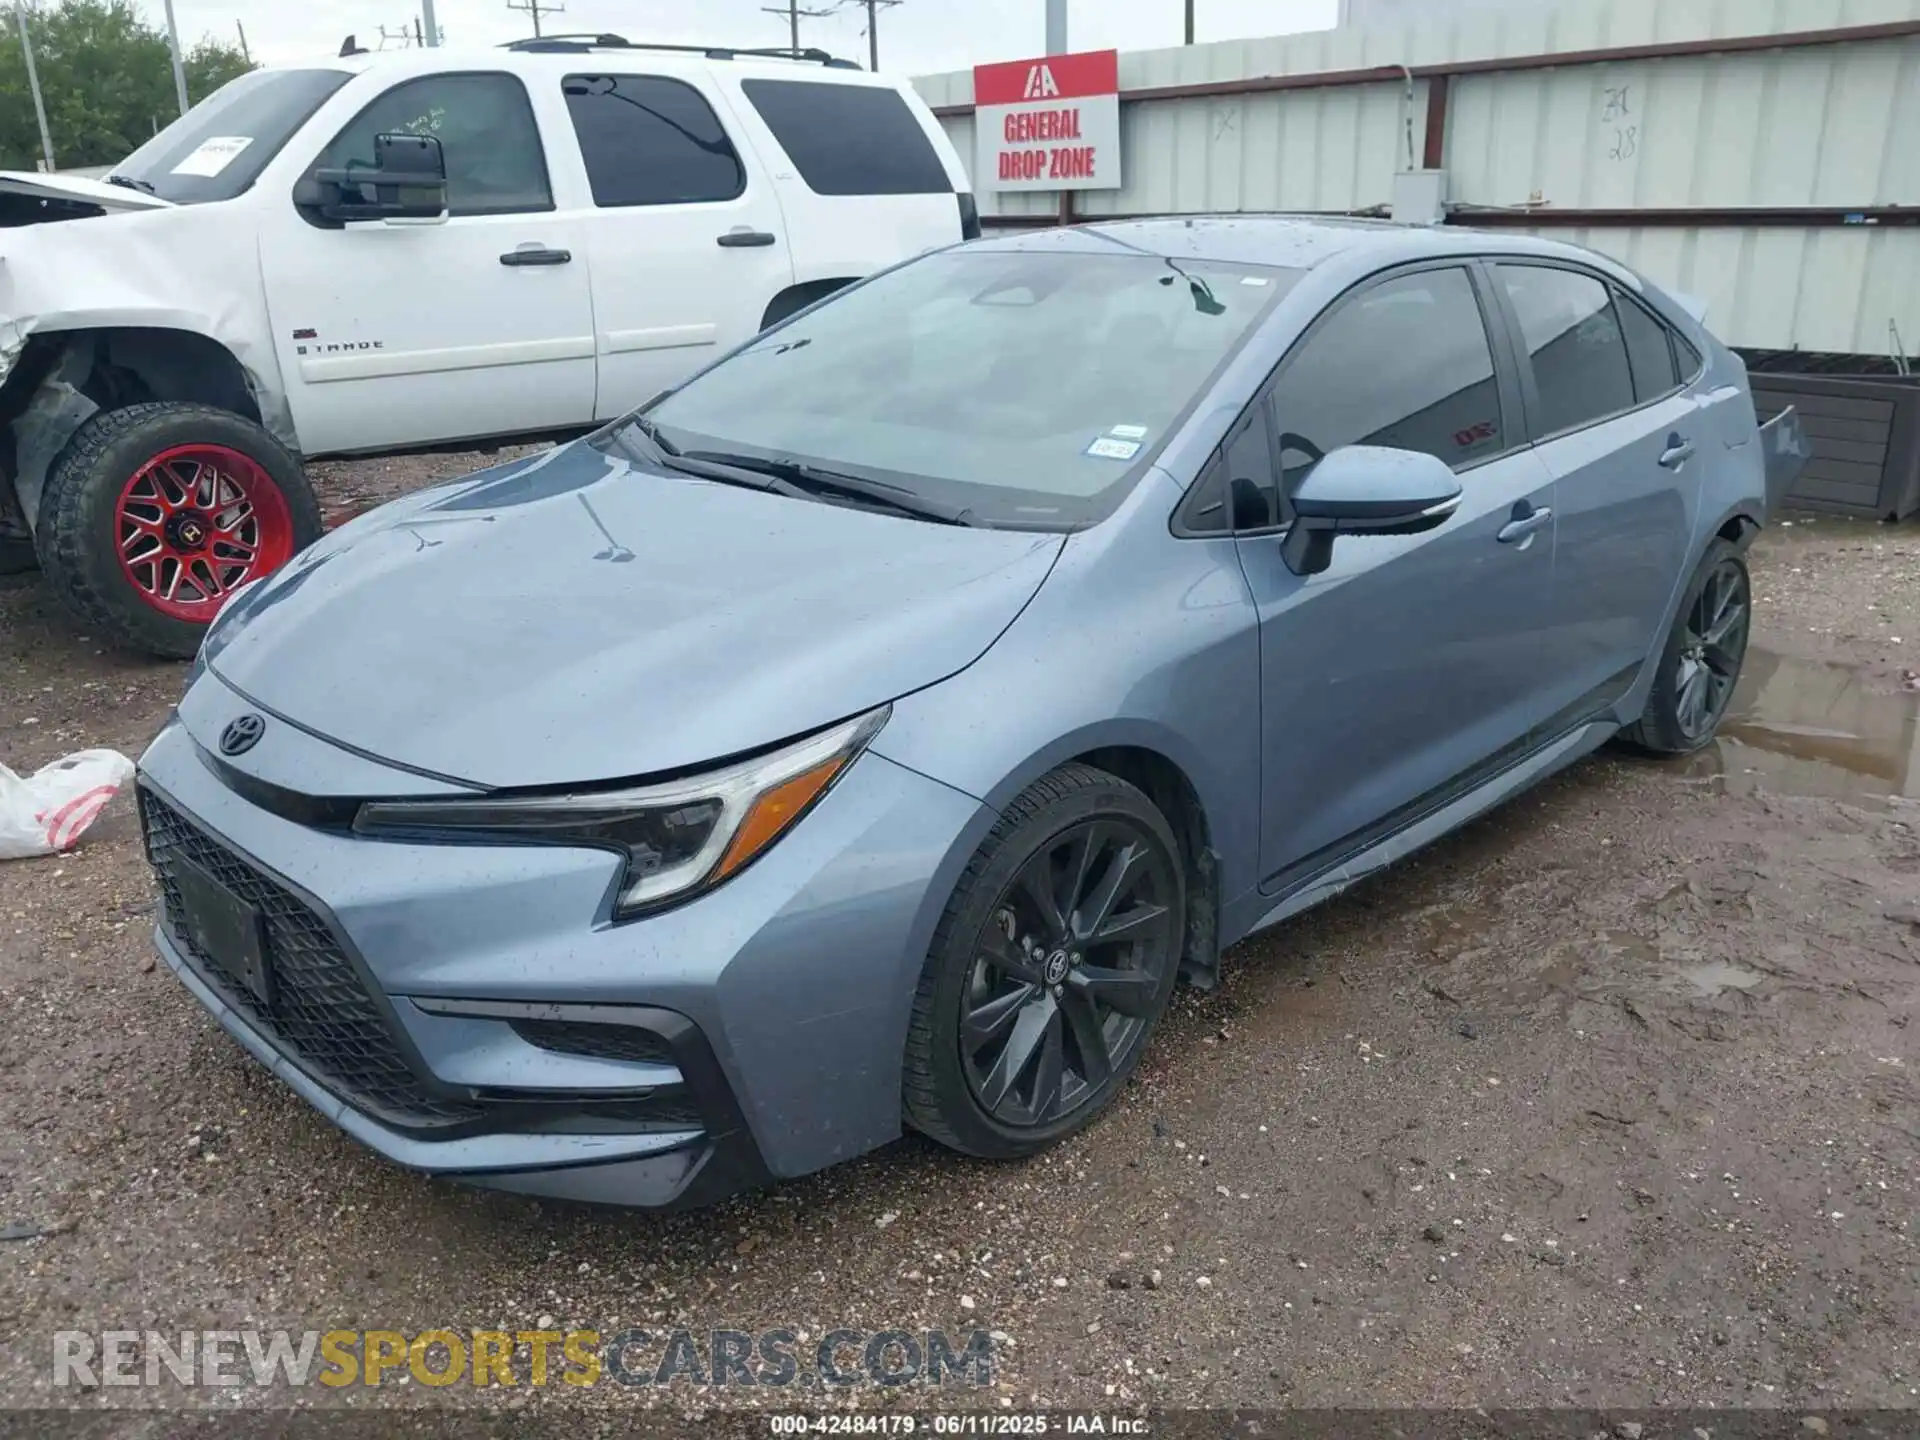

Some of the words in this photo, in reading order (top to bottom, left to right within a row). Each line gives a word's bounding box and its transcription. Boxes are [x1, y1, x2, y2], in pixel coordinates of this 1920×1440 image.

[1004, 109, 1081, 143] GENERAL
[998, 150, 1046, 181] DROP
[1050, 147, 1096, 179] ZONE
